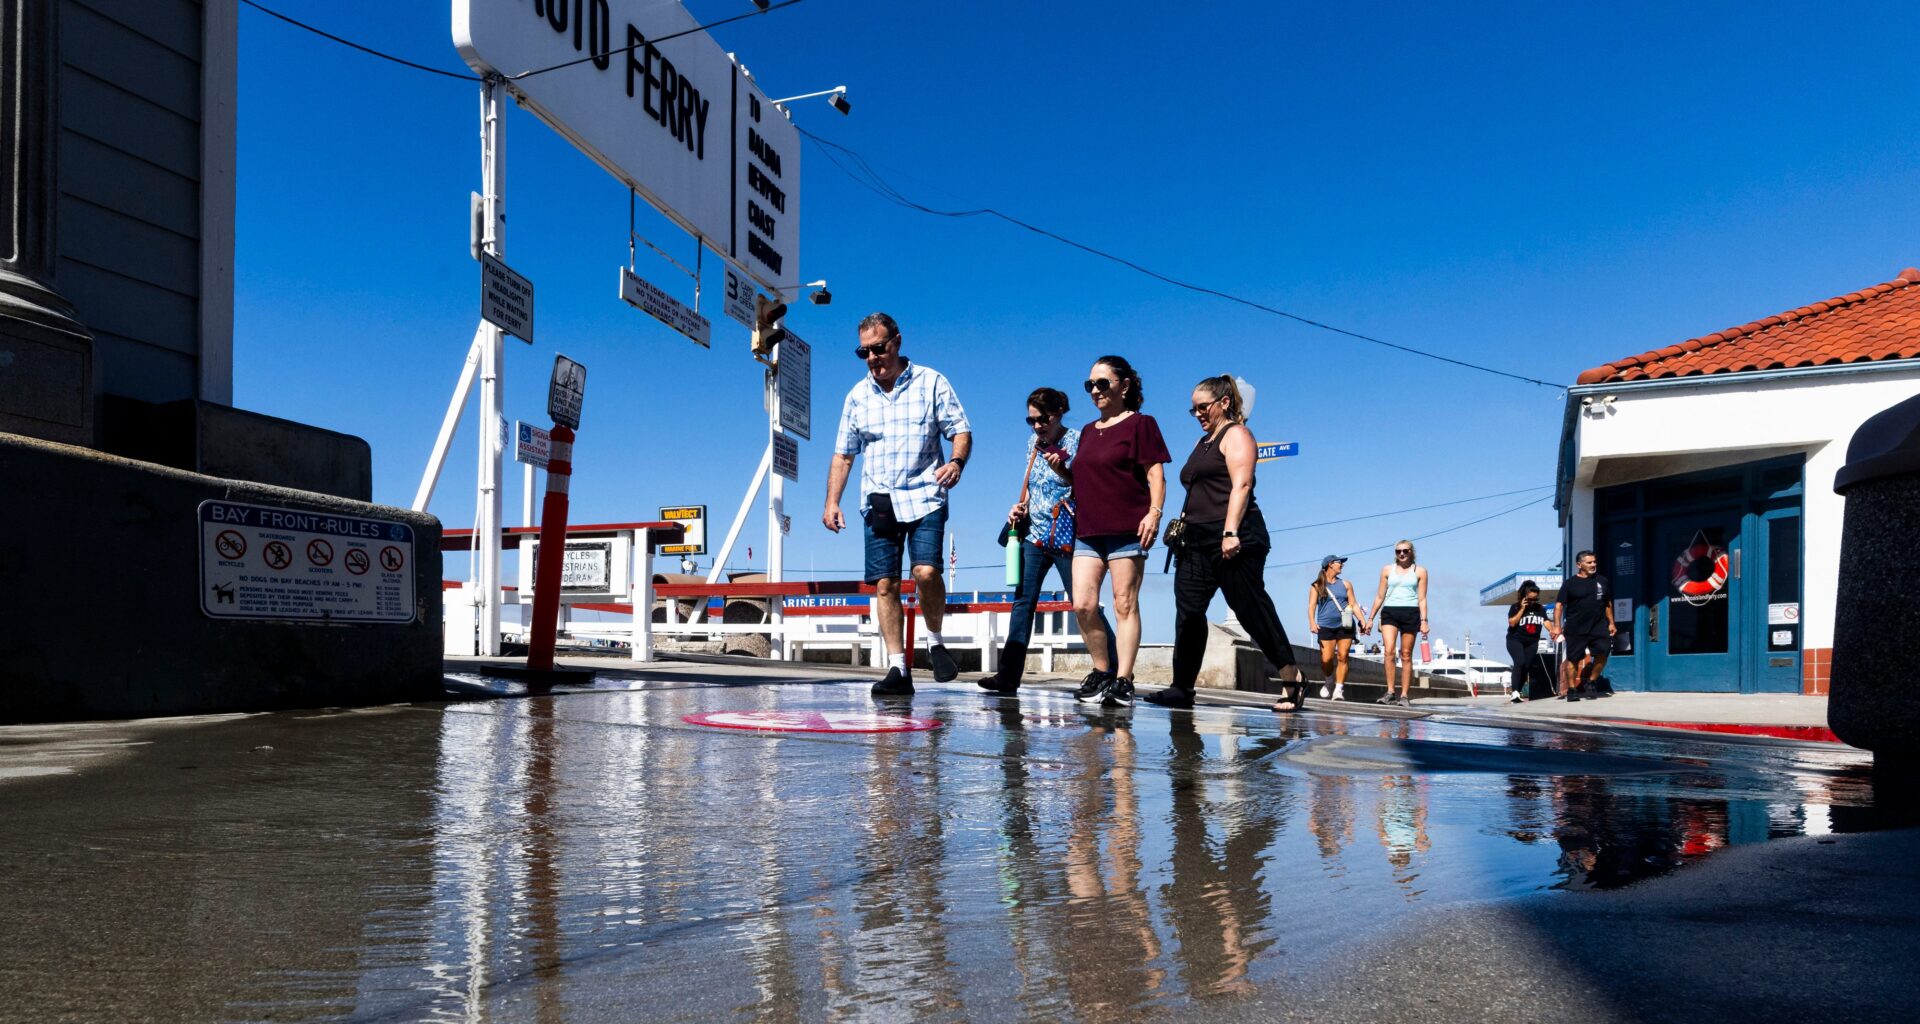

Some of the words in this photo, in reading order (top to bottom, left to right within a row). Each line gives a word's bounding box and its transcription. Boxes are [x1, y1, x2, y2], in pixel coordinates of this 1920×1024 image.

[533, 0, 609, 71] TO
[627, 23, 710, 160] FERRY
[749, 92, 761, 123] TO
[749, 126, 782, 179] BALBOA
[748, 161, 786, 215] NEWPORT
[748, 199, 776, 241] COAST
[485, 262, 505, 283] PLEASE
[506, 275, 521, 291] TURN
[521, 285, 532, 299] OFF
[625, 269, 649, 290] VEHICLE
[650, 284, 665, 300] LOAD
[667, 295, 680, 309] LIMIT
[727, 270, 739, 301] 3
[740, 280, 754, 296] CARS
[492, 280, 525, 308] HEADLIGHTS
[488, 291, 506, 308] WHILE
[506, 301, 528, 322] WAITING
[636, 287, 645, 297] NO
[646, 293, 671, 314] TRAILERS
[671, 308, 679, 317] OR
[680, 314, 701, 331] HITCHES
[643, 300, 675, 324] CLEARANCE
[739, 296, 756, 313] GREEN
[493, 307, 504, 321] FOR
[504, 314, 522, 330] FERRY
[784, 332, 795, 346] ASH
[553, 404, 569, 417] YOUR
[554, 397, 567, 407] AND
[568, 401, 581, 413] WALK
[519, 442, 550, 458] ASSISTANC
[537, 439, 547, 449] FOR
[1258, 446, 1277, 458] GATE
[211, 505, 249, 524] BAY
[259, 510, 320, 530] FRONT
[327, 520, 380, 538] RULES
[664, 509, 698, 520] VALVTECT
[258, 532, 296, 542] SKATEBOARDS
[218, 560, 246, 568] BICYCLES
[566, 552, 590, 560] YCLES
[308, 567, 334, 575] SCOOTERS
[239, 575, 250, 583] NO
[252, 576, 267, 584] DOGS
[269, 576, 279, 584] ON
[281, 577, 293, 585] BAY
[294, 577, 321, 586] BEACHES
[783, 598, 815, 607] ARINE
[819, 598, 850, 607] FUEL
[1519, 615, 1545, 627] UTAH
